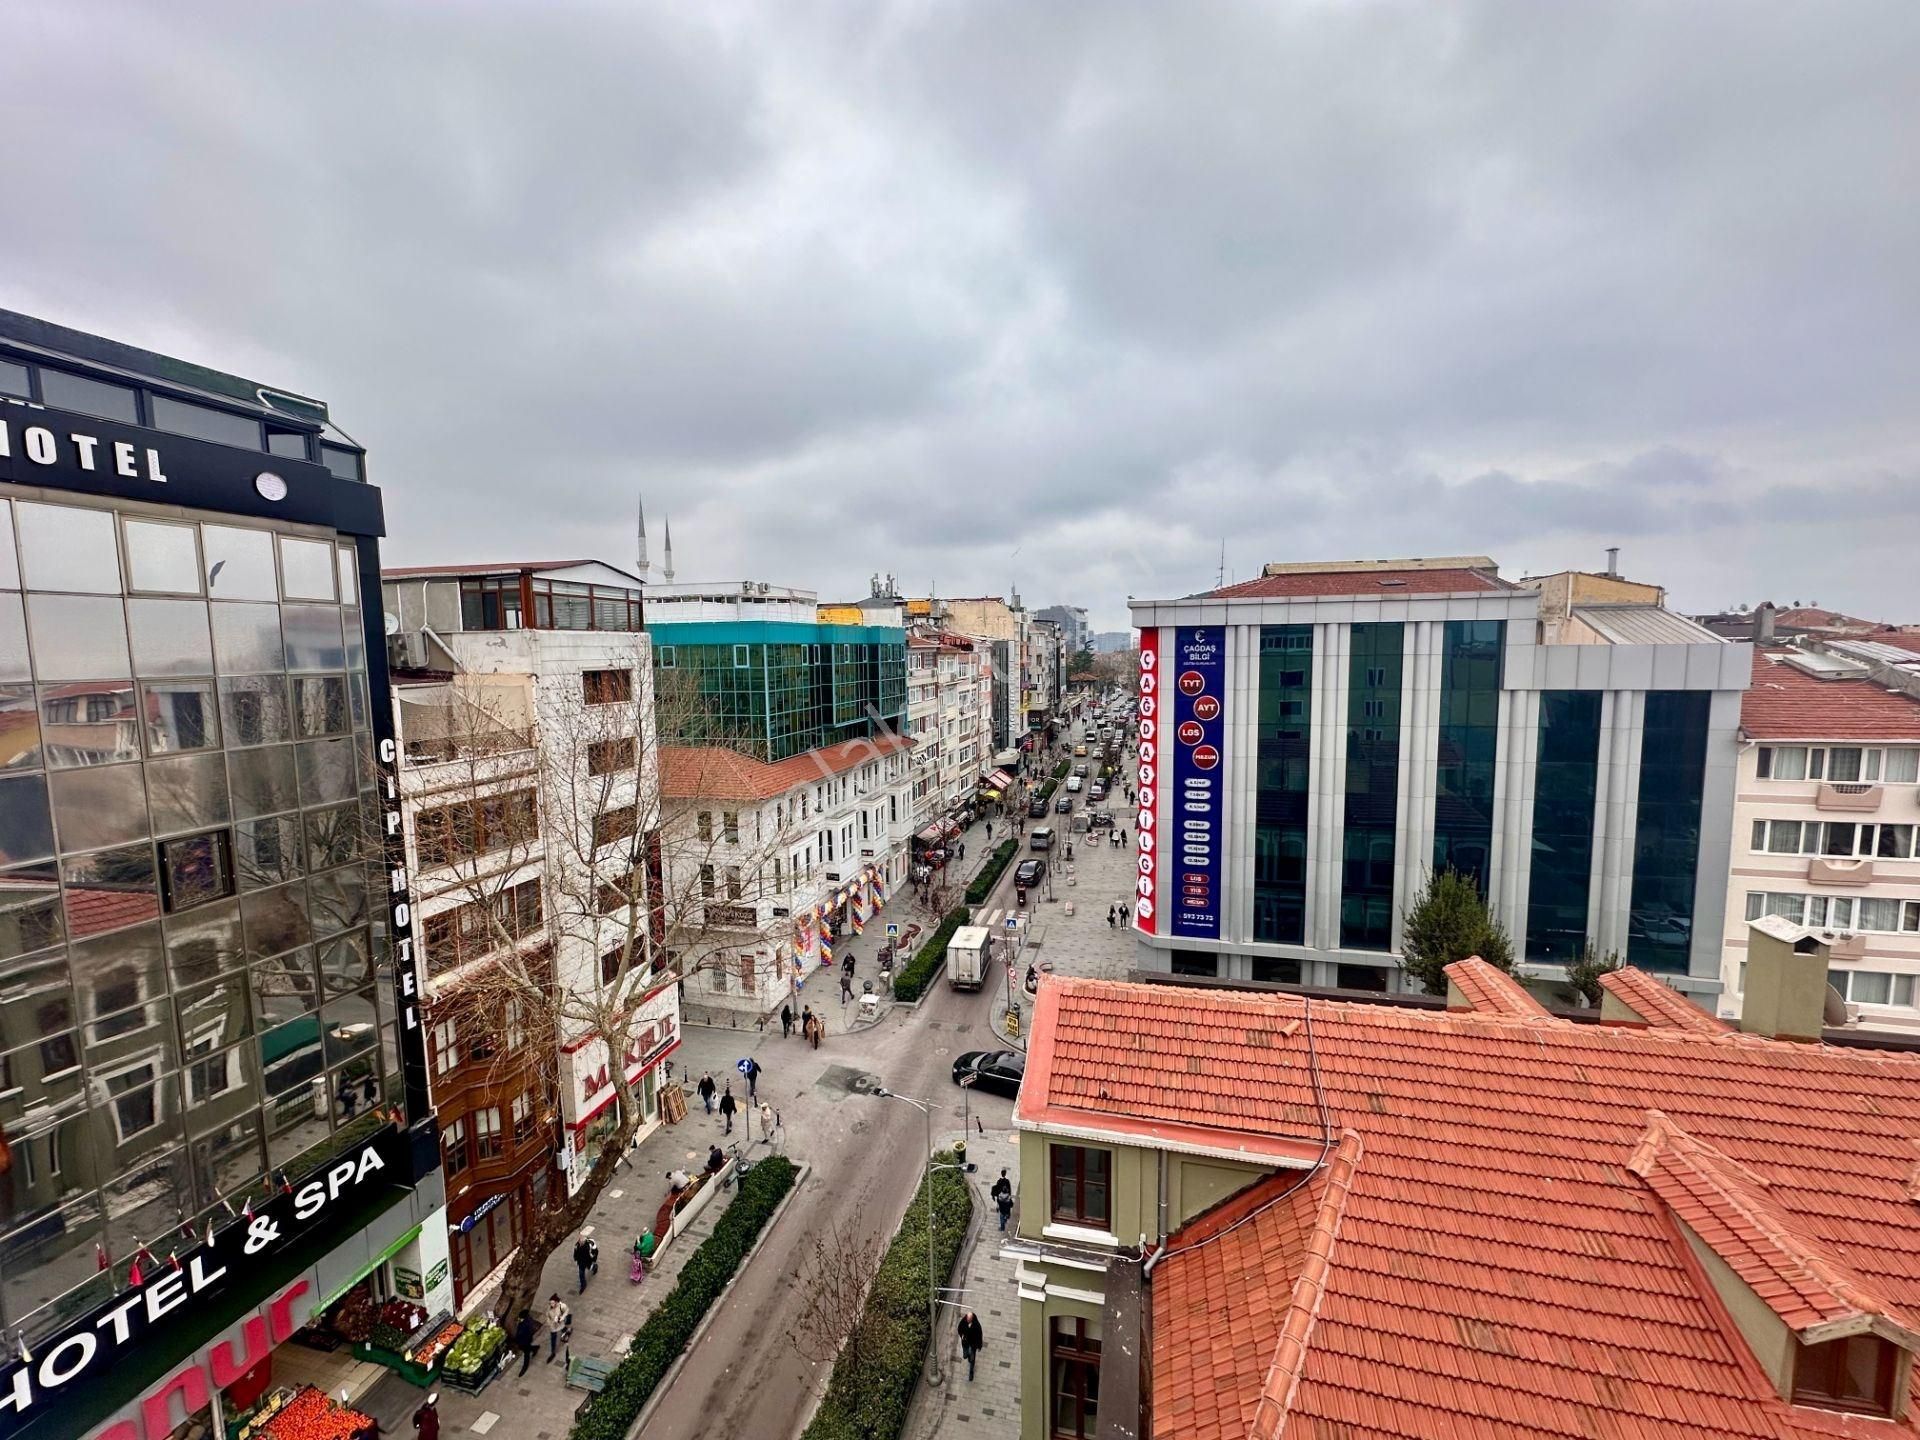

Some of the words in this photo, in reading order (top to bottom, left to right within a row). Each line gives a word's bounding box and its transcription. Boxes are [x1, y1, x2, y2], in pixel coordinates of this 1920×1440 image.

[1183, 644, 1216, 653] ÇAĞDAŞ
[1189, 652, 1210, 661] BİLGİ
[1183, 679, 1201, 687] TYT
[1142, 653, 1151, 782] ÇAĞDAŞ
[1197, 704, 1215, 712] AYT
[1182, 729, 1200, 737] LGS
[1141, 790, 1150, 894] BİLGİ
[391, 867, 416, 1031] HOTEL
[583, 1015, 677, 1102] MKBUL
[243, 1215, 282, 1255] &
[294, 1145, 385, 1221] SPA
